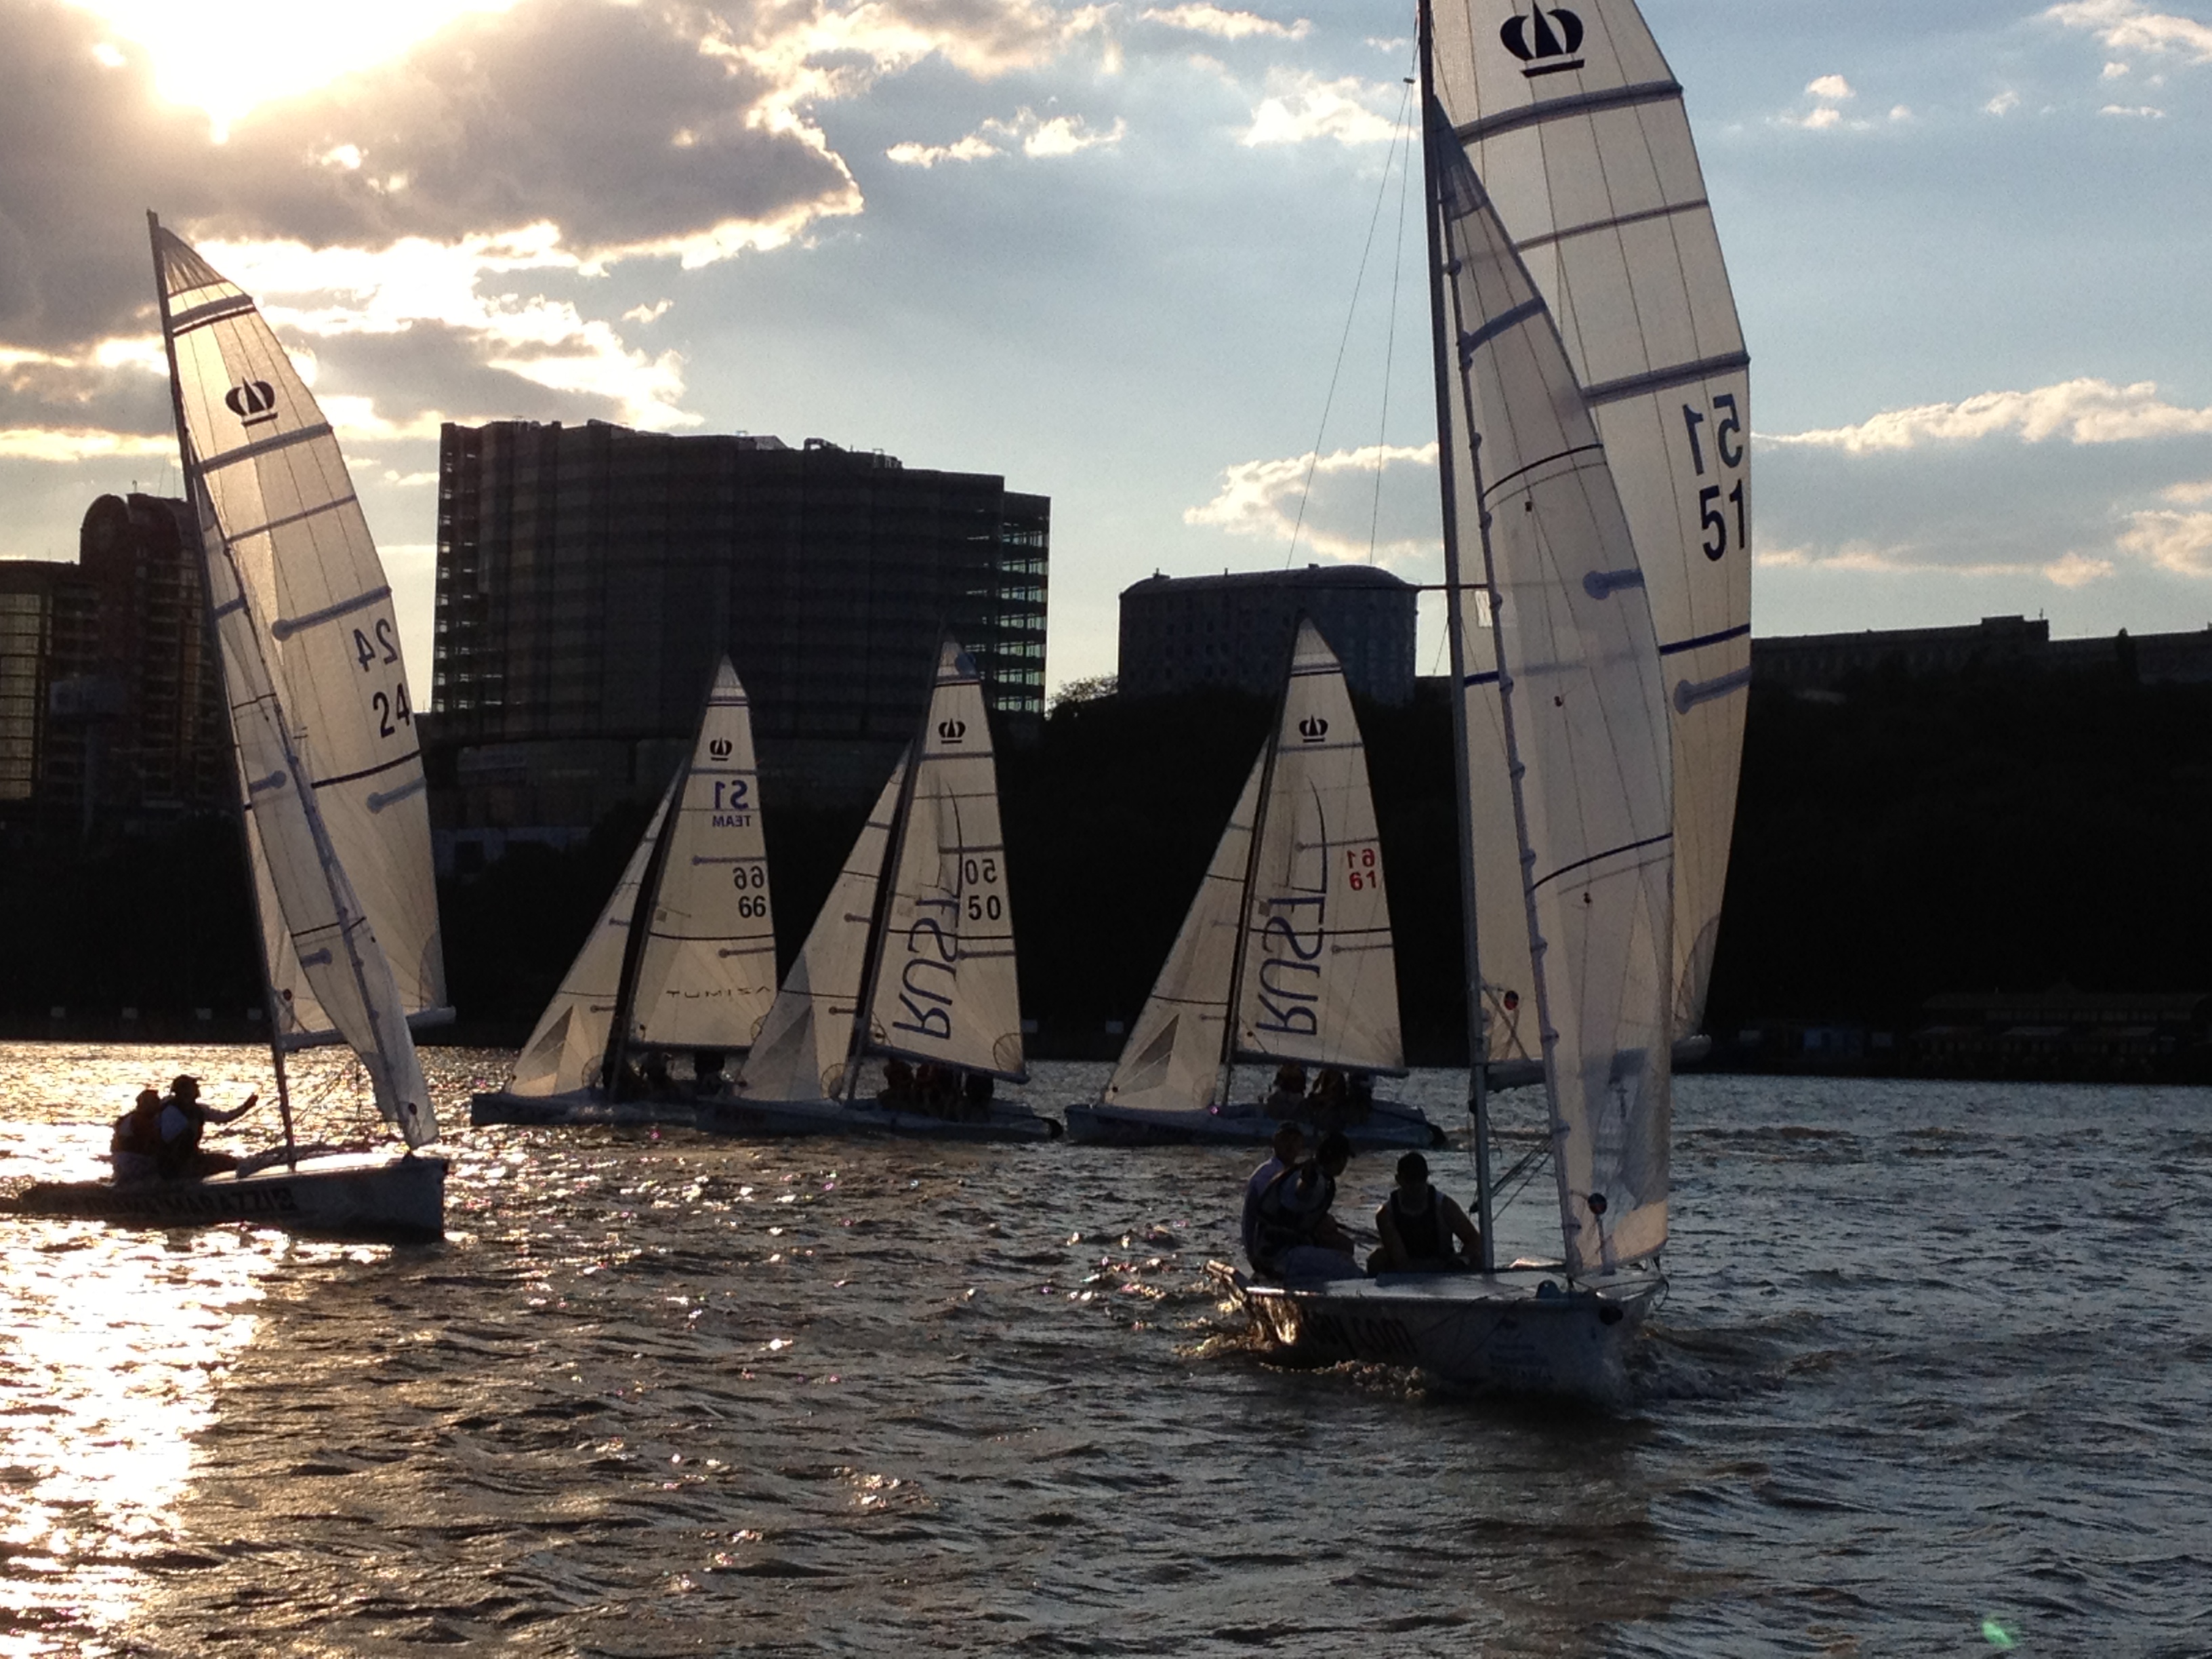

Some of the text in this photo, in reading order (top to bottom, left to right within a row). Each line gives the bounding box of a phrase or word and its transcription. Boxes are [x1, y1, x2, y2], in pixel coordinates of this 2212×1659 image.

[1699, 478, 1745, 562] 51
[373, 682, 410, 739] 24
[1349, 871, 1377, 891] 61
[738, 895, 766, 918] 66
[968, 895, 1001, 920] 50
